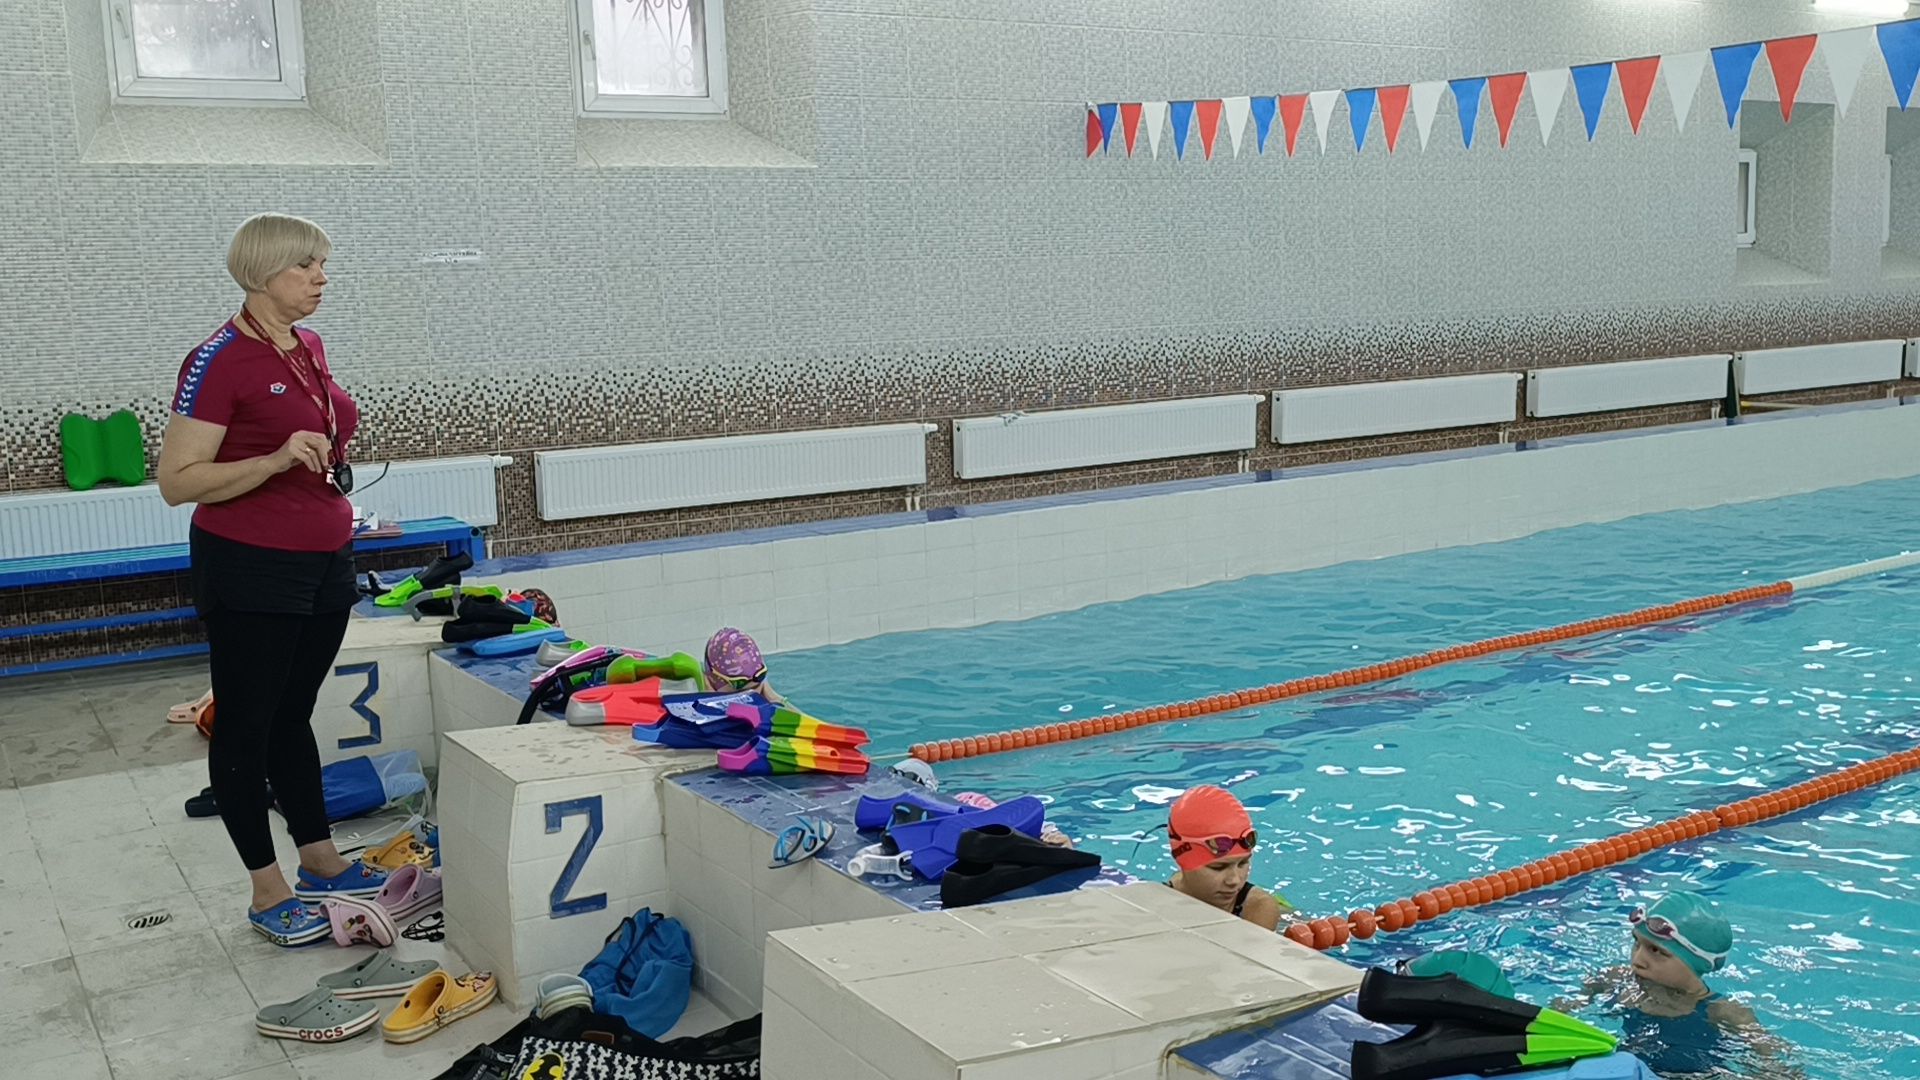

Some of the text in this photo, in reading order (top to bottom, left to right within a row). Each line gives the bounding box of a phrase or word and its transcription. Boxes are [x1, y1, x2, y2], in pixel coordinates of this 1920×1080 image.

[335, 661, 381, 749] 3
[544, 795, 607, 919] 2
[299, 1026, 344, 1040] crocs
